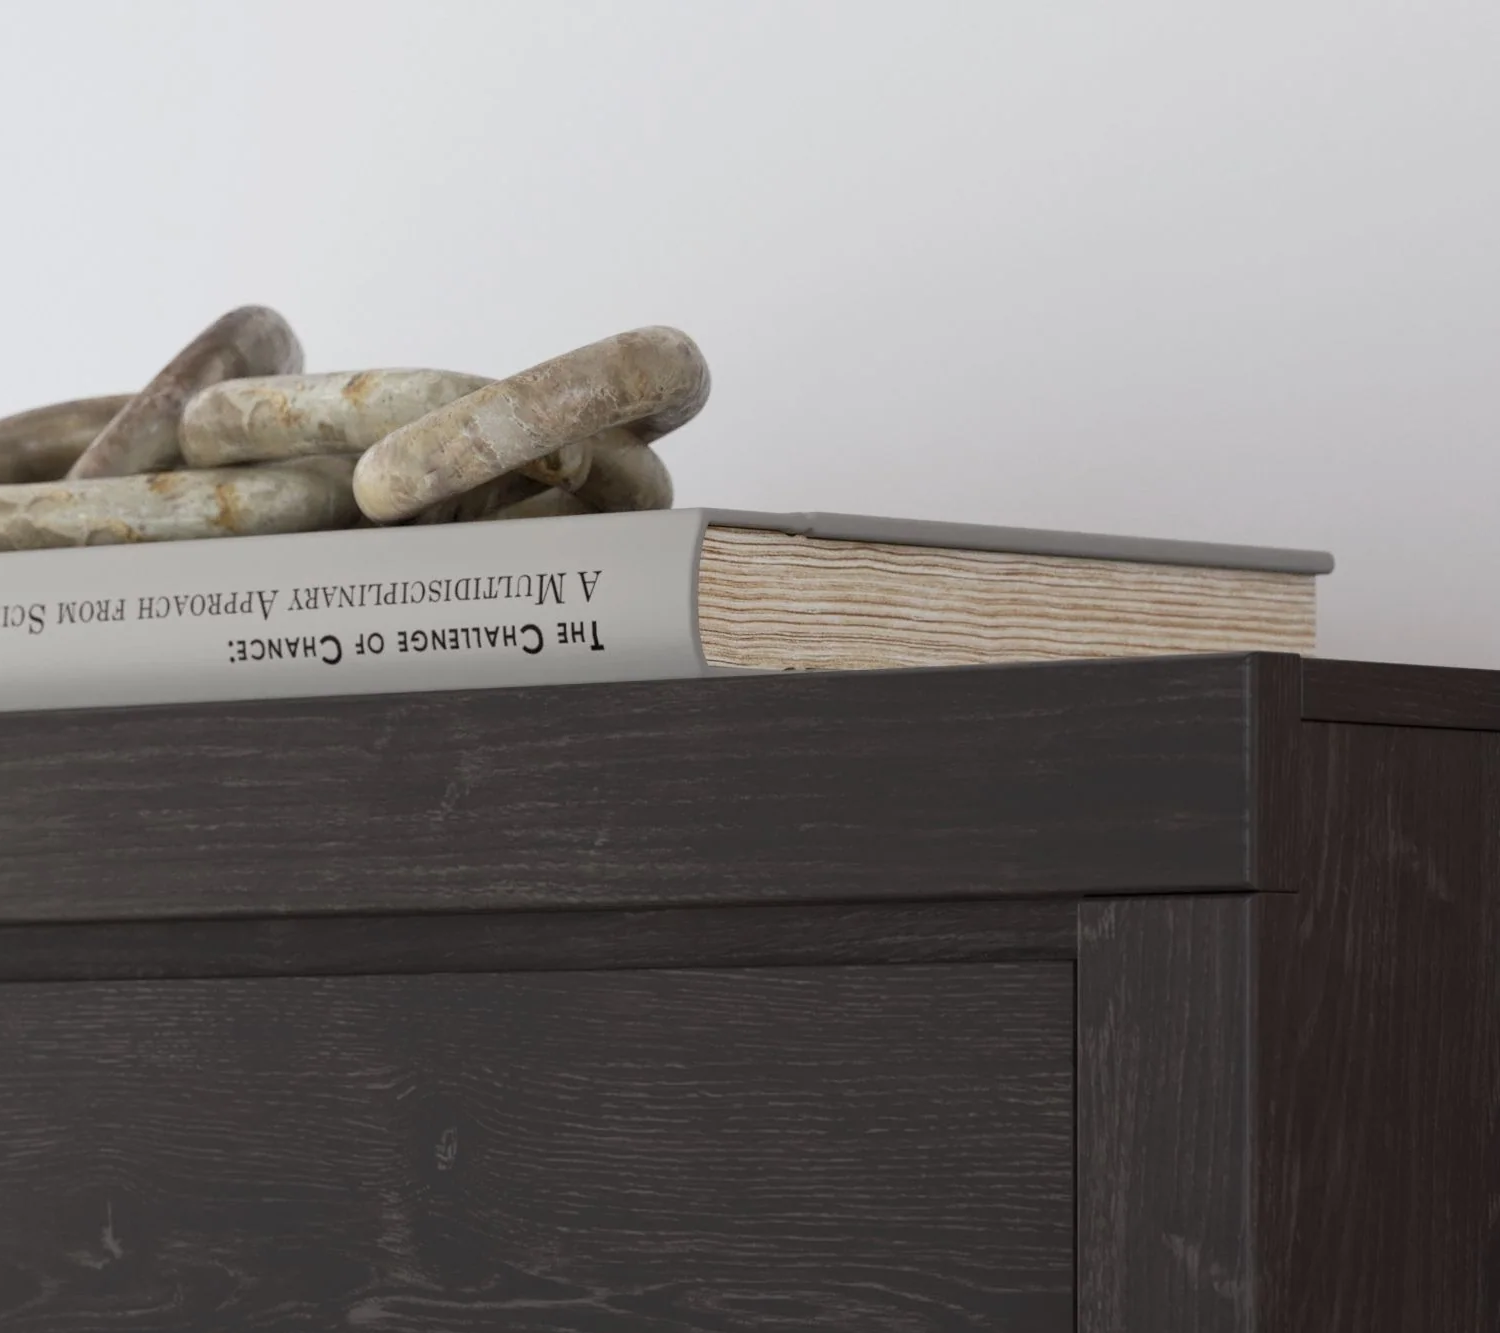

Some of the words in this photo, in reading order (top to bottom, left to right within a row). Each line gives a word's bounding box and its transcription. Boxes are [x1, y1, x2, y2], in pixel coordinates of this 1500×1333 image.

[286, 571, 568, 612] MULTIDISCIPLINARY
[576, 569, 603, 604] A
[56, 598, 127, 625] FROM
[137, 588, 280, 621] APPROACH
[227, 634, 343, 666] CHANCE:
[354, 631, 385, 656] OF
[396, 623, 545, 656] CHALLENGE
[556, 620, 606, 652] THE
